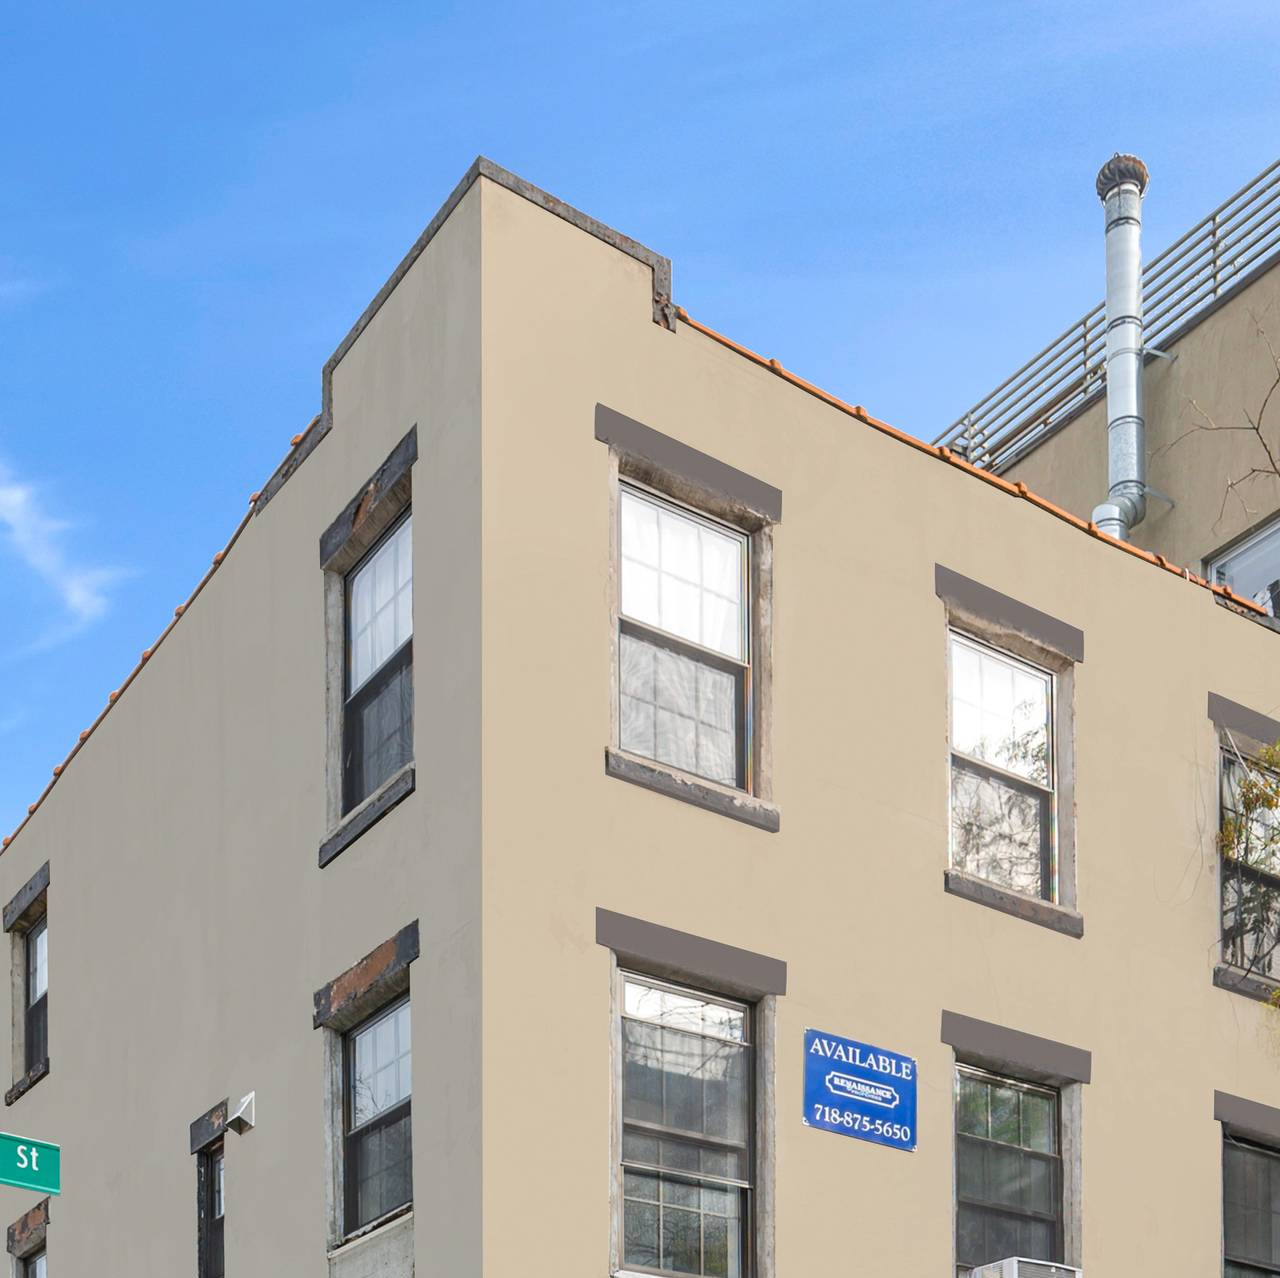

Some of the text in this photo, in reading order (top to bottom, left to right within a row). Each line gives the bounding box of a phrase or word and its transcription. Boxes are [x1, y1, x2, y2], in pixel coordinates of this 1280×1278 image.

[810, 1038, 912, 1080] AVAILABLE
[833, 1077, 892, 1099] RENAISSANCE
[814, 1104, 911, 1142] 718-875-5650
[16, 1144, 40, 1172] St
